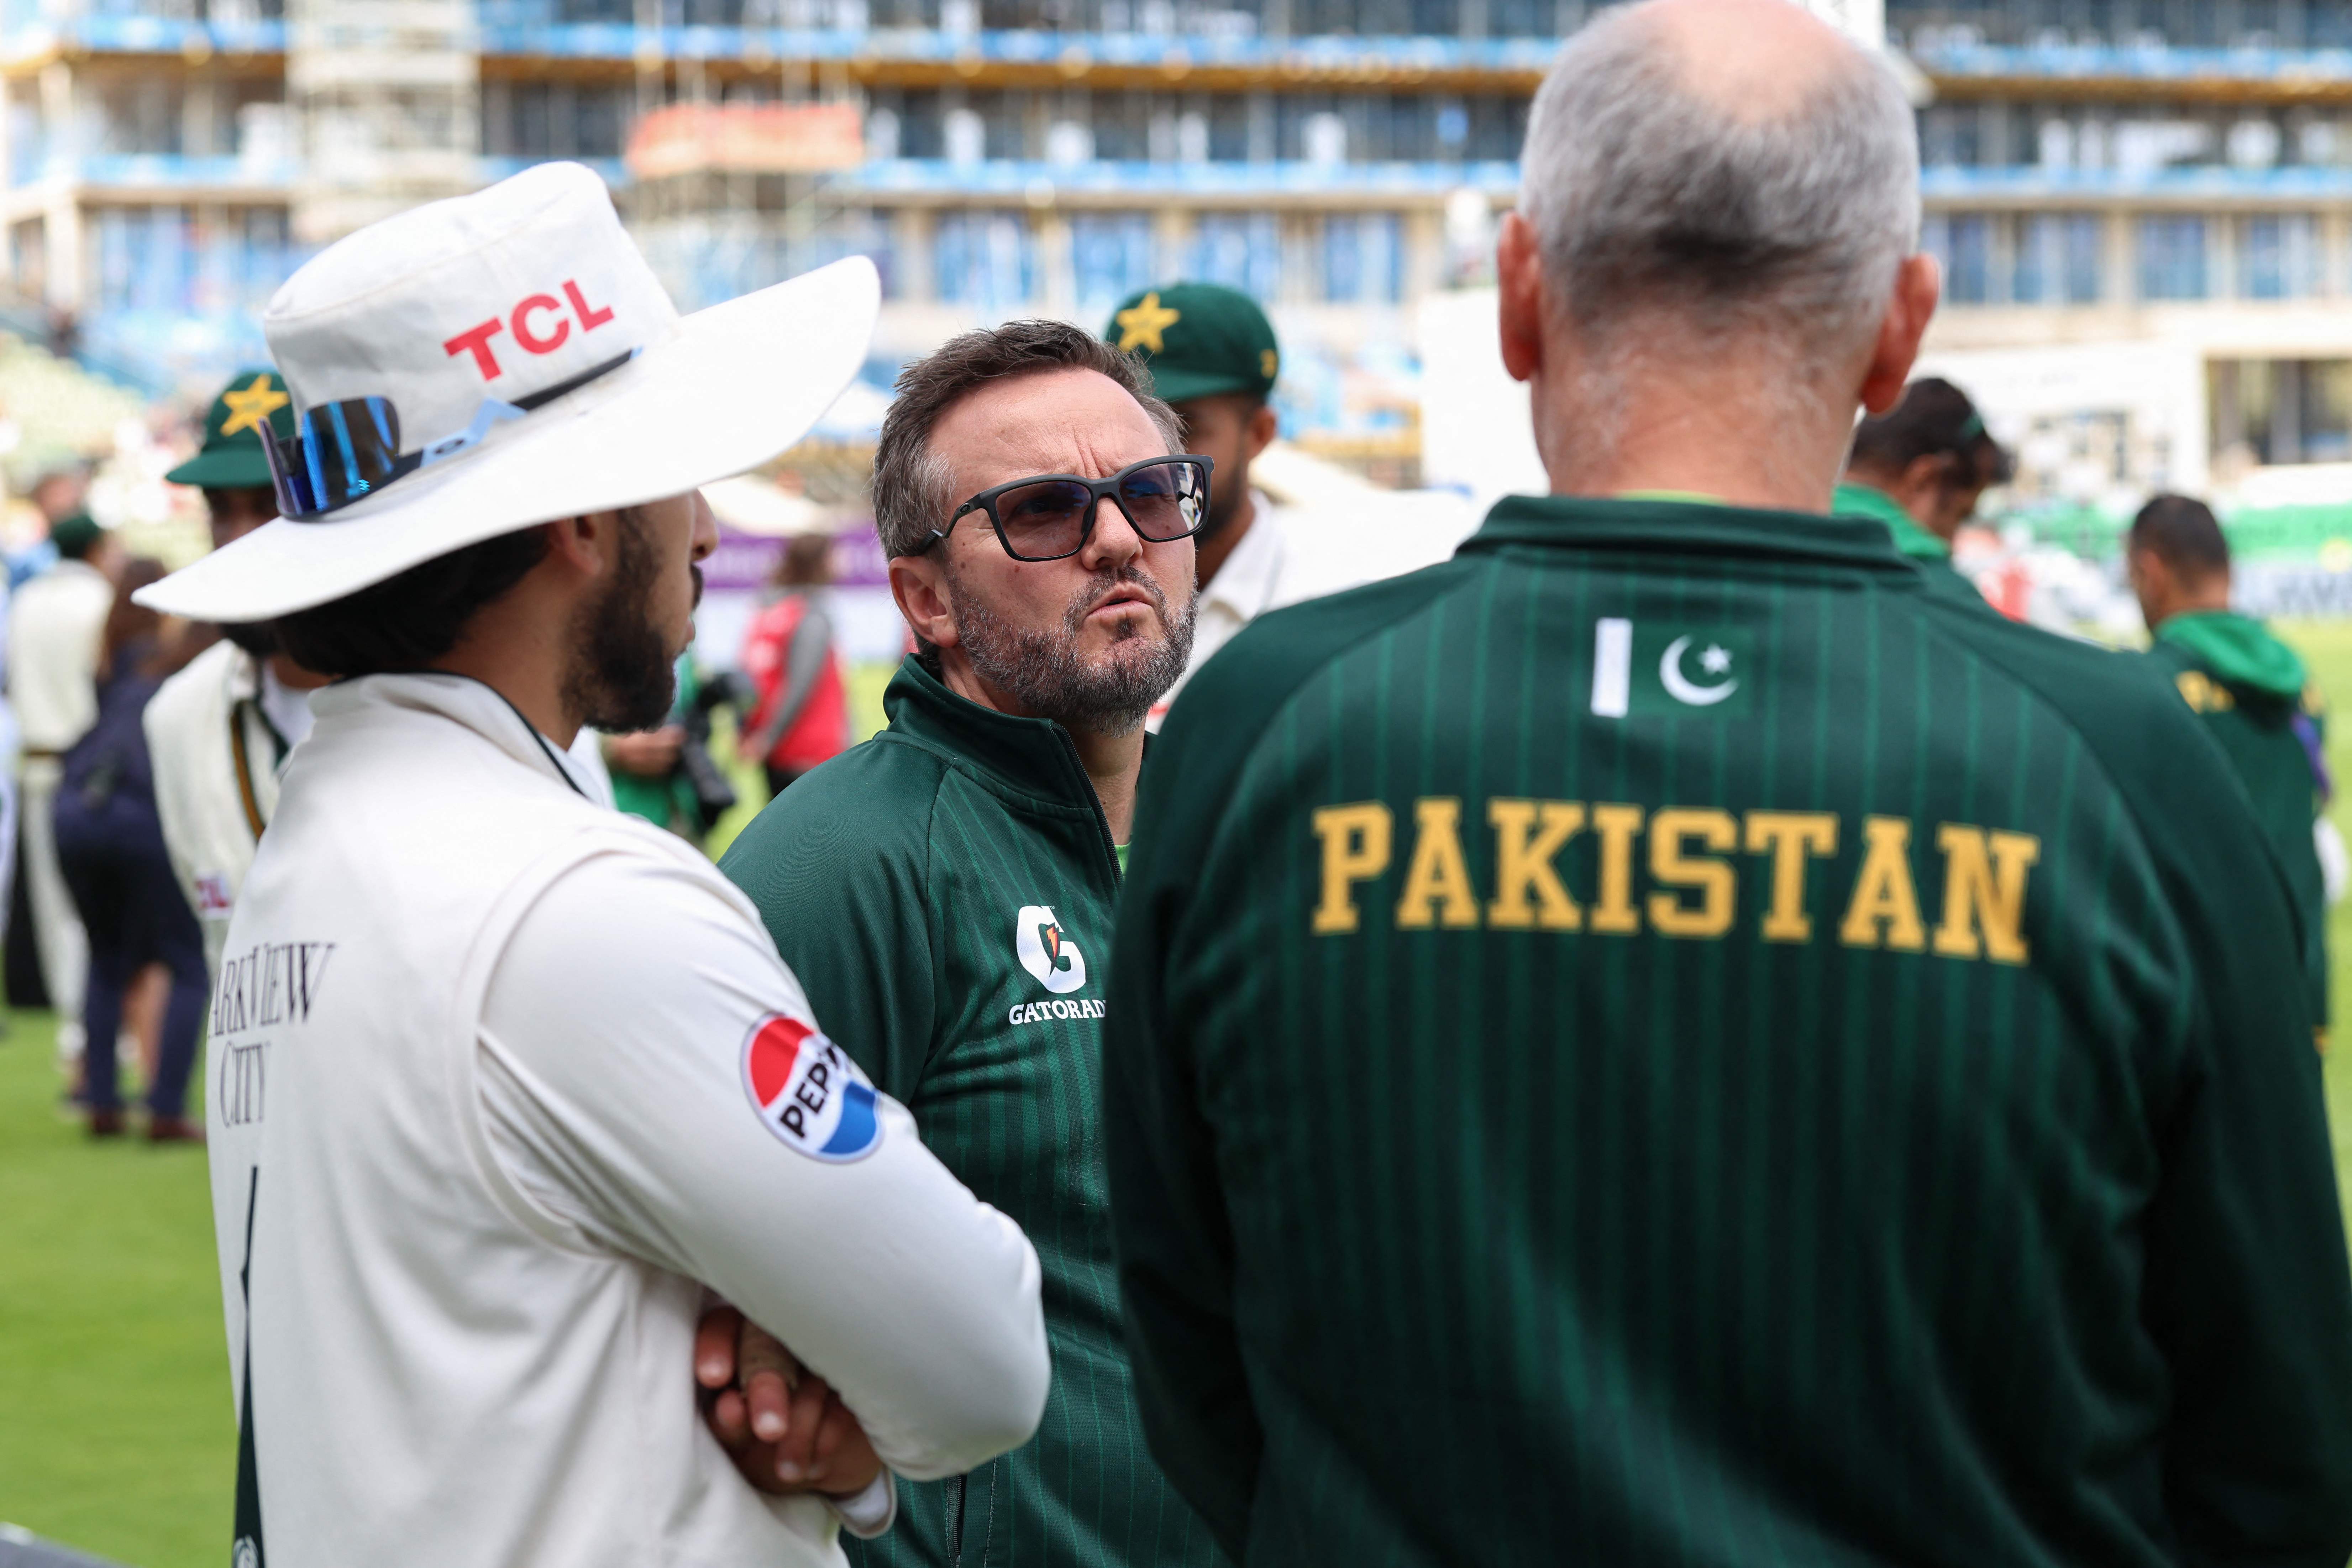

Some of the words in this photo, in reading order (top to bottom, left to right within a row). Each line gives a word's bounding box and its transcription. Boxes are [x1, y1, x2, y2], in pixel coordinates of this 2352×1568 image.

[443, 279, 615, 382] TCL
[1311, 796, 2041, 965] PAKISTAN
[206, 943, 335, 1037] ARKVIEW
[1009, 999, 1106, 1025] GATORAD
